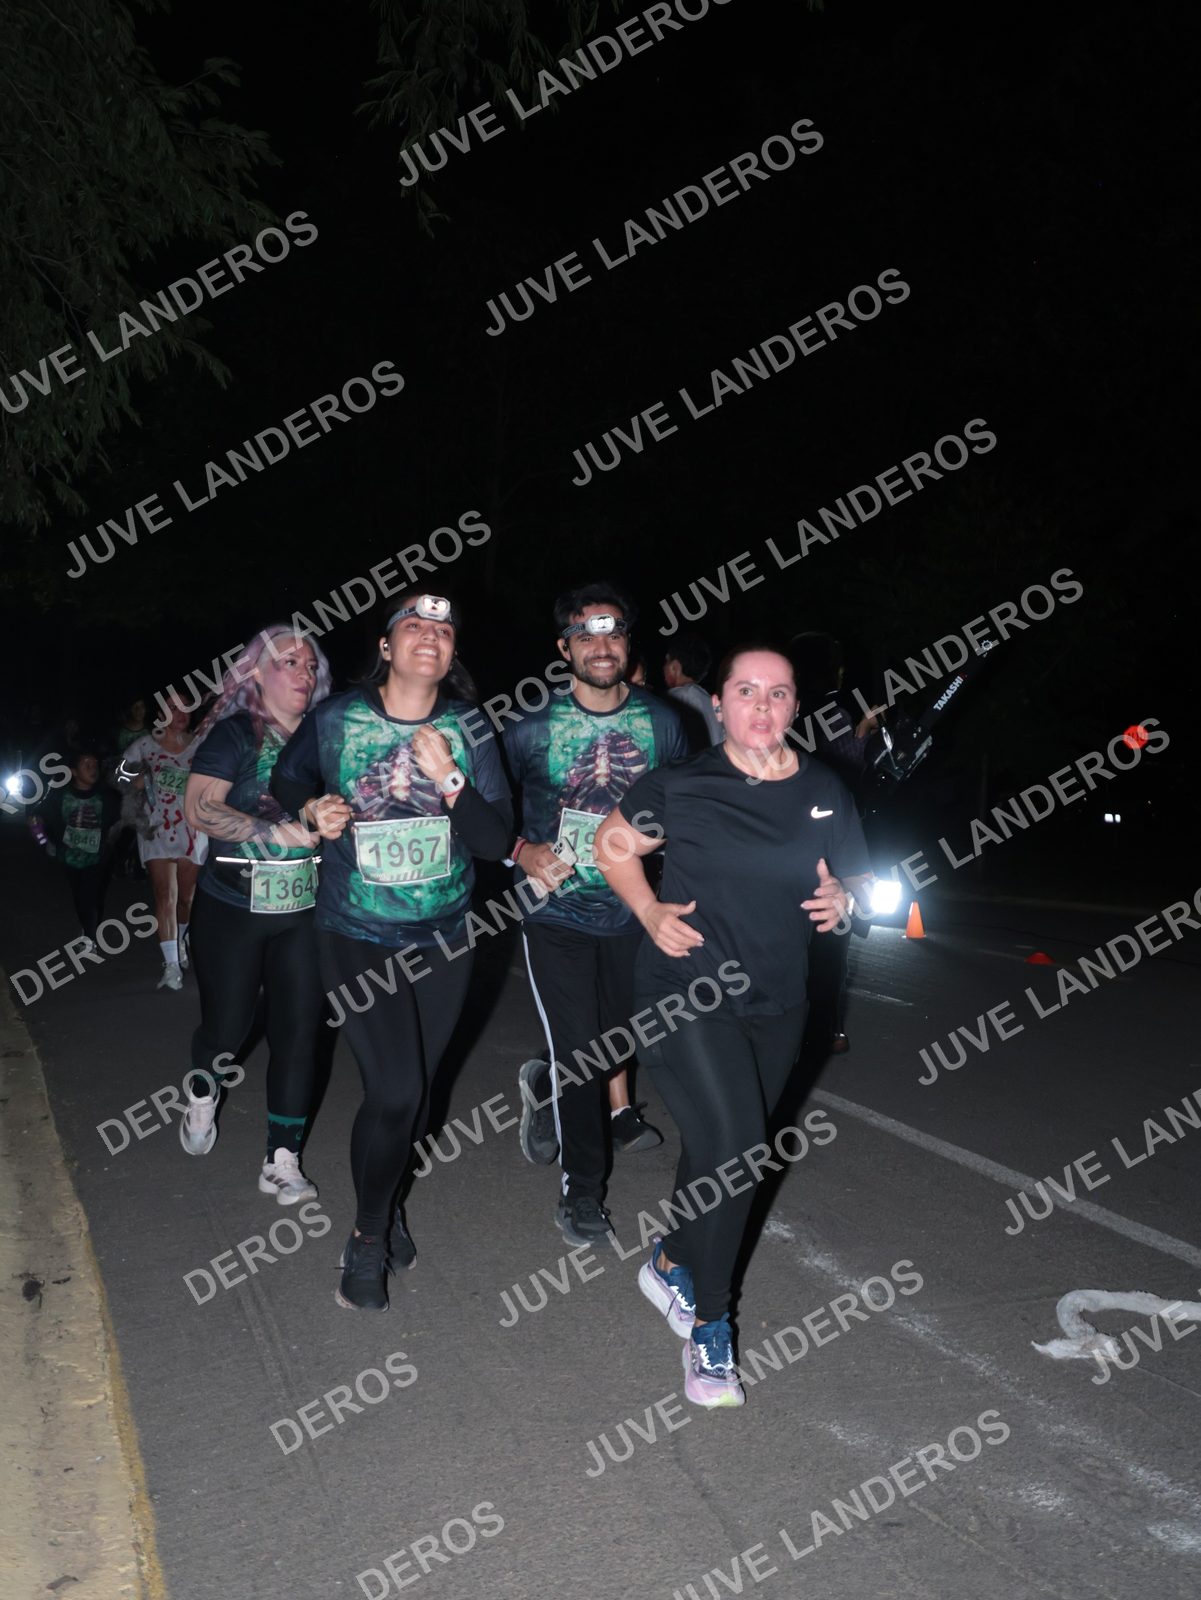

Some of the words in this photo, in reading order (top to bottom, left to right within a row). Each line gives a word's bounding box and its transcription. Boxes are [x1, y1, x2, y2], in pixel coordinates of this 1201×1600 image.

[933, 676, 963, 711] TAKASHI
[368, 836, 441, 868] 1967
[261, 873, 314, 899] 1364
